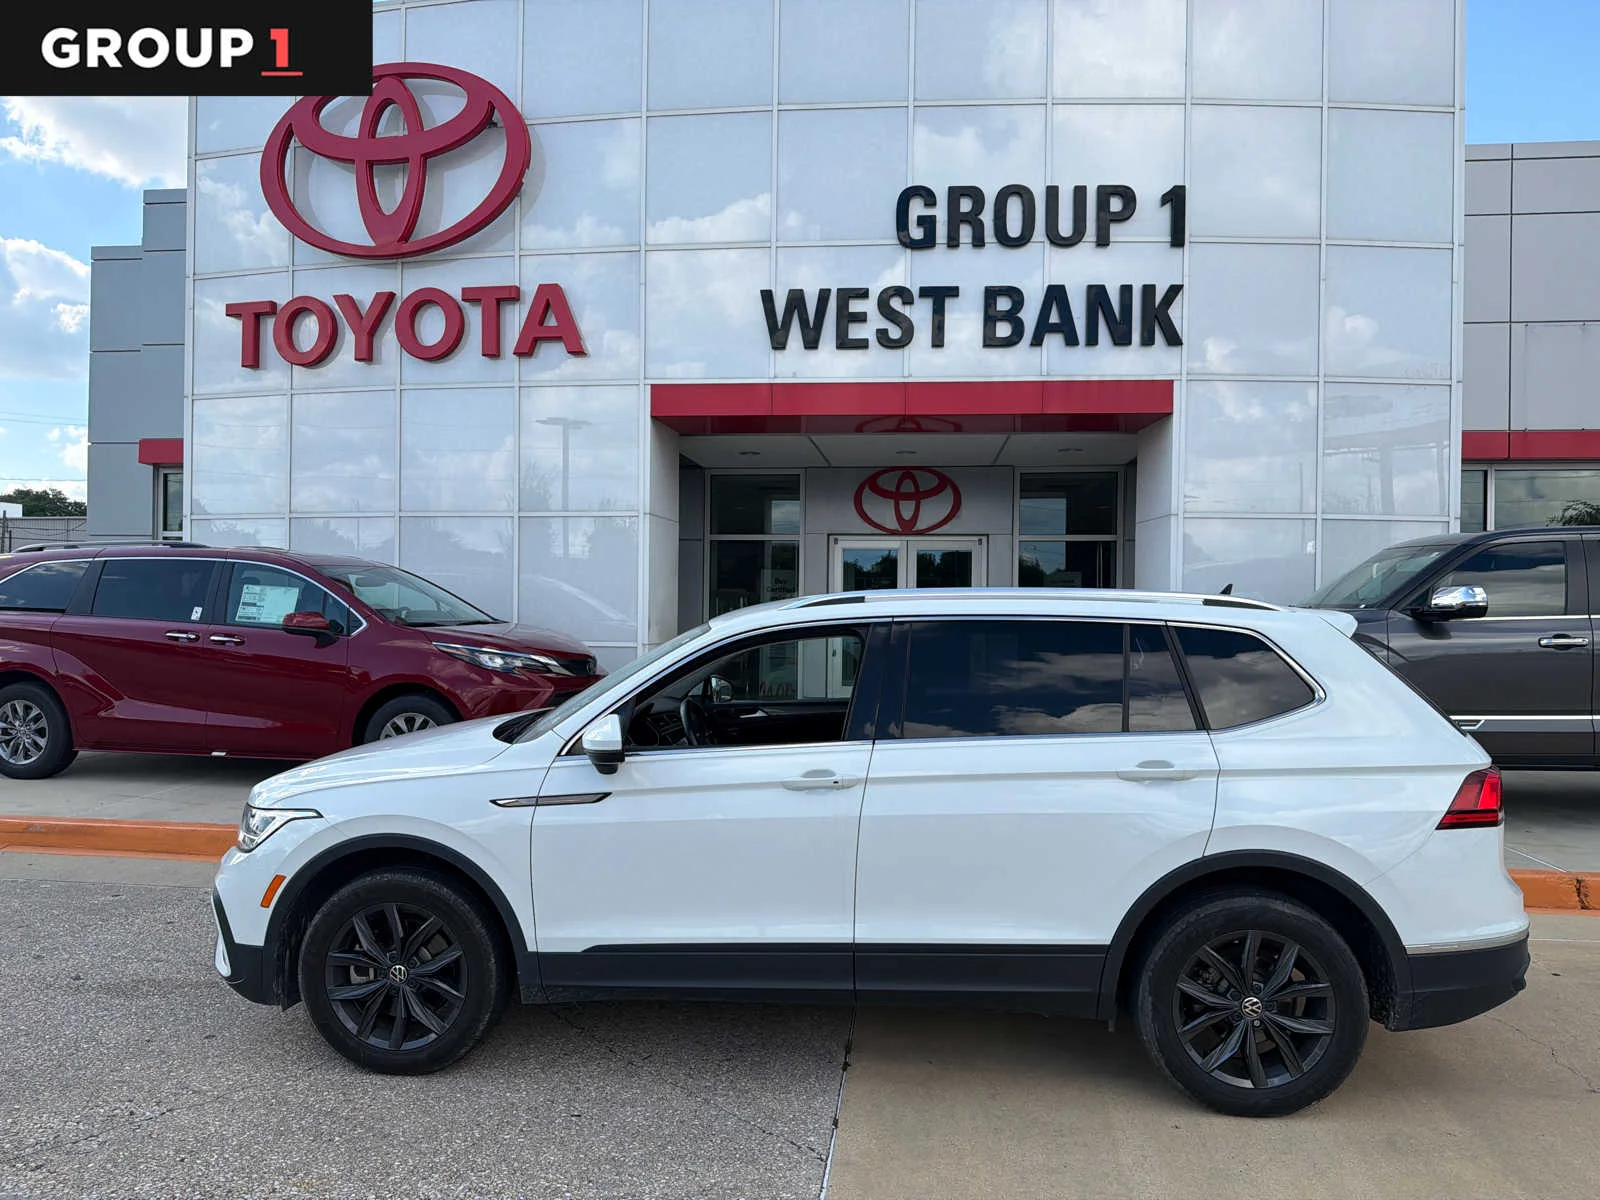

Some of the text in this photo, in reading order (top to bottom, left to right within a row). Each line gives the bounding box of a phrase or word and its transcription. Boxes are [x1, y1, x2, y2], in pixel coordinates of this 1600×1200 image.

[895, 184, 1187, 252] GROUP 1
[226, 283, 587, 369] TOYOTA
[760, 283, 1184, 351] WEST BANK
